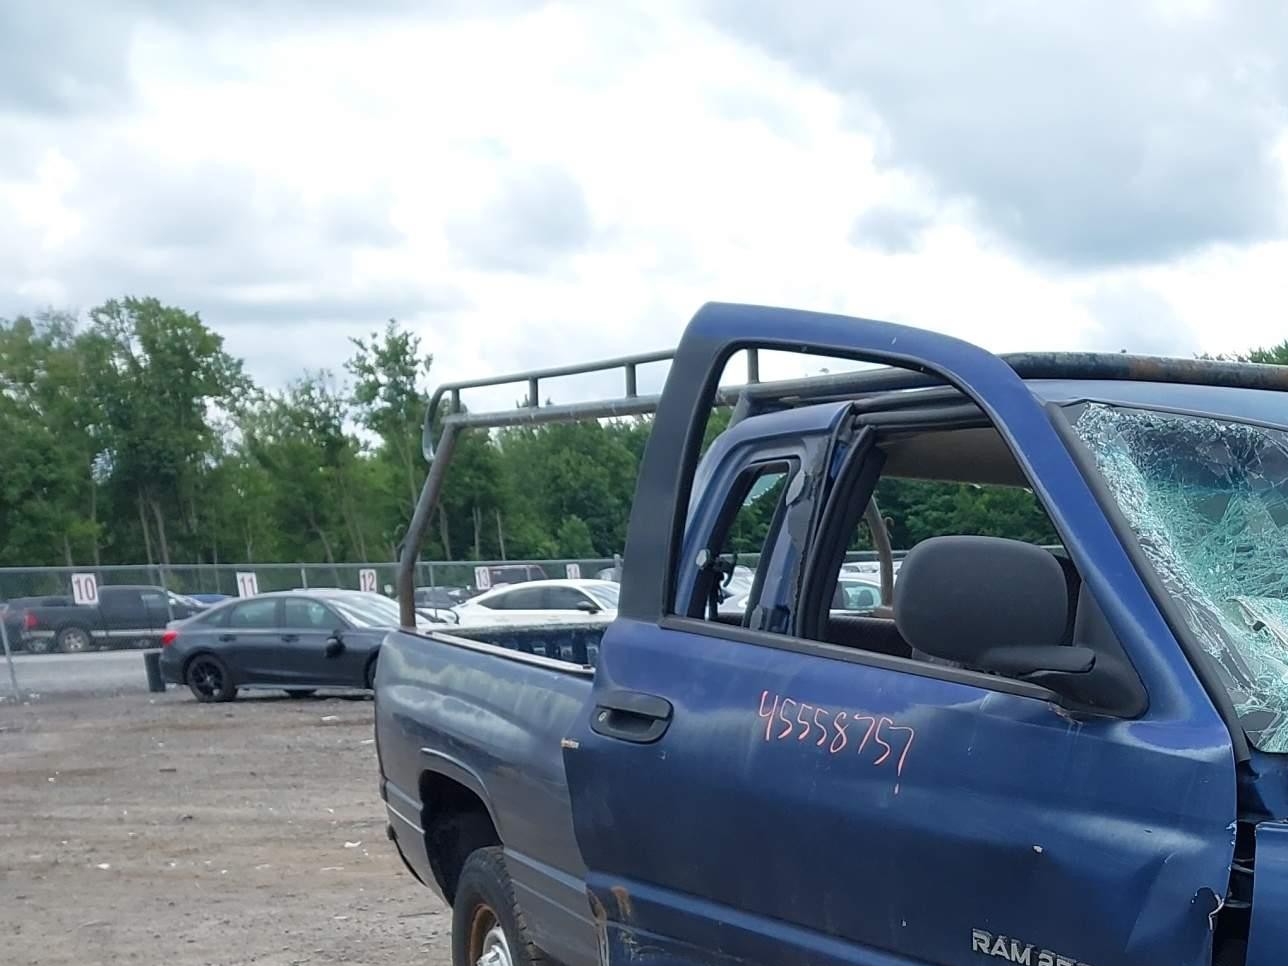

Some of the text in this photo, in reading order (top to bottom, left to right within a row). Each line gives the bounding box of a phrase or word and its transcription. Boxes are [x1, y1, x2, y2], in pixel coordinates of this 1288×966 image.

[74, 577, 96, 601] 10
[240, 576, 257, 597] 11
[361, 573, 376, 592] 12
[758, 690, 915, 777] 45558757
[972, 928, 1033, 966] RAM
